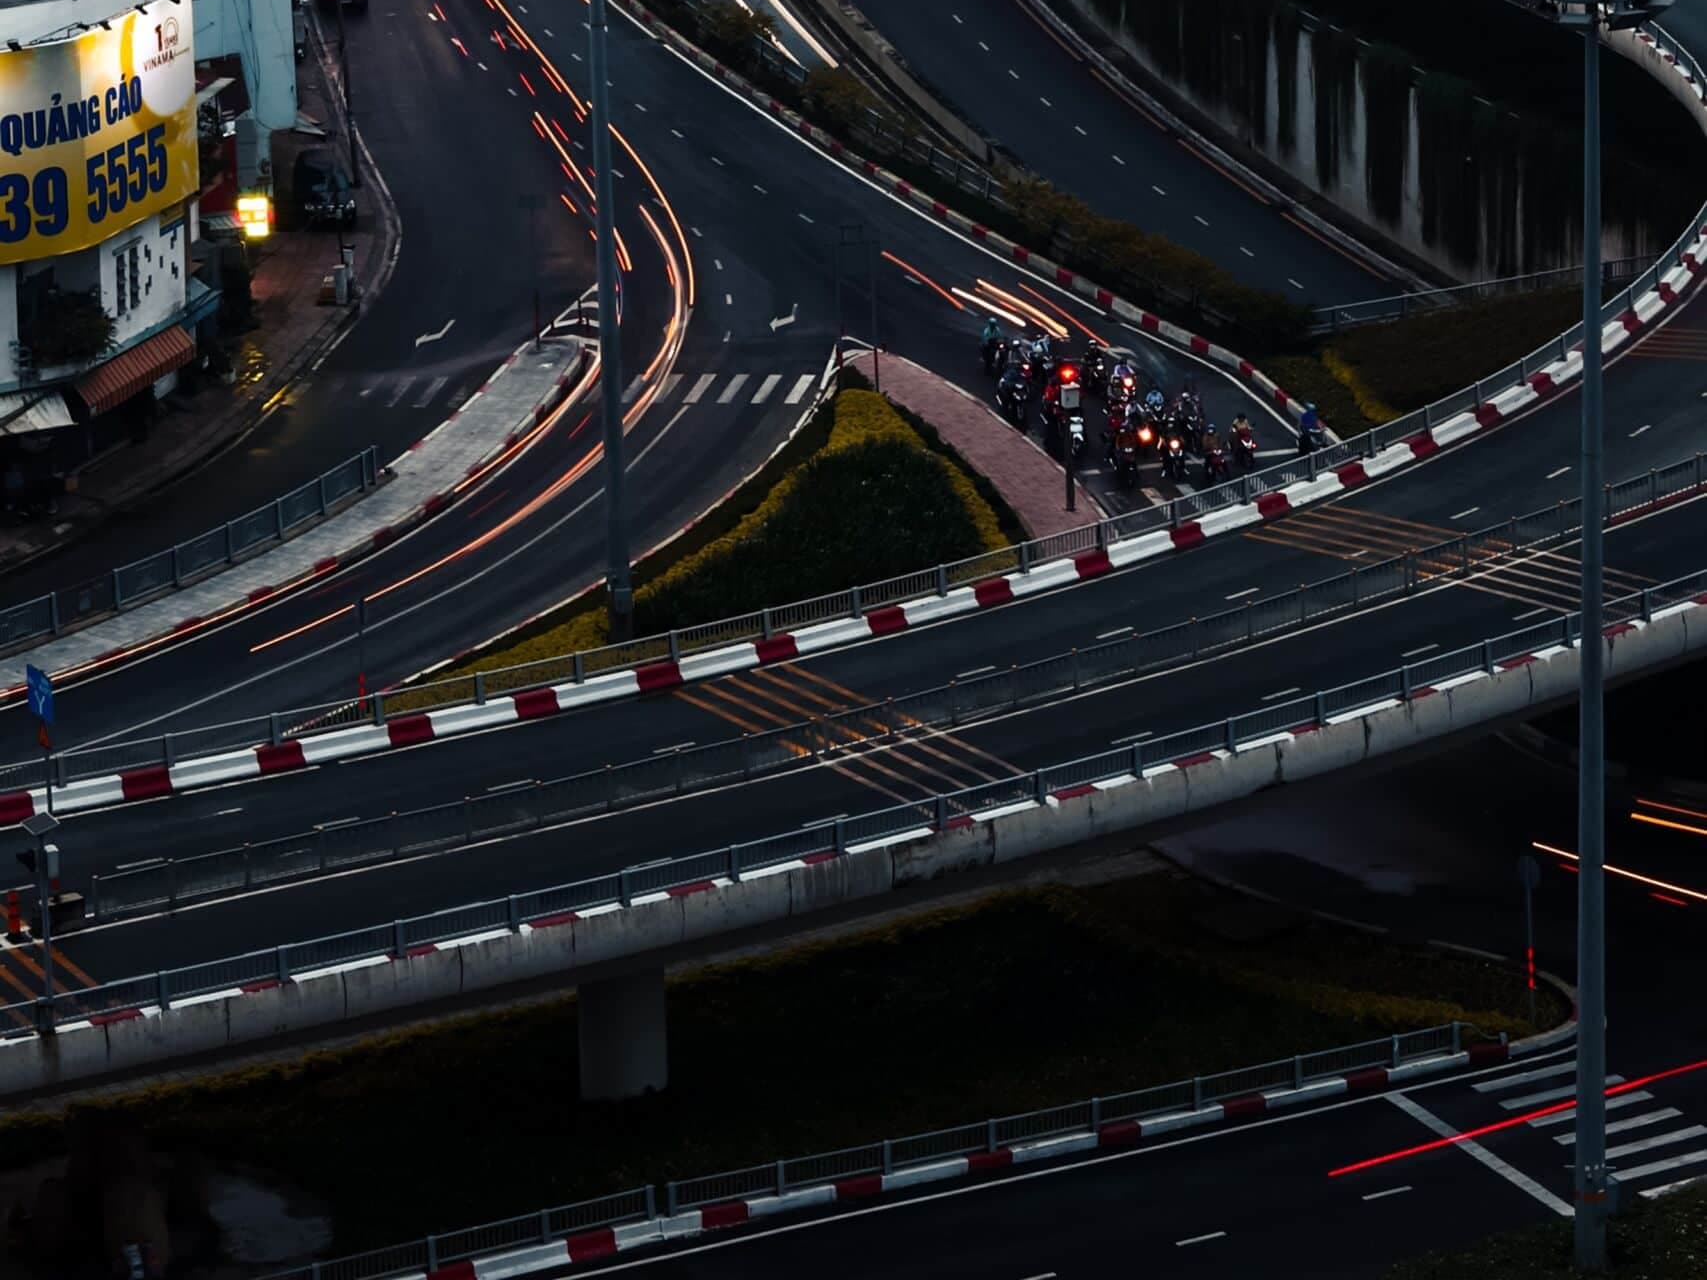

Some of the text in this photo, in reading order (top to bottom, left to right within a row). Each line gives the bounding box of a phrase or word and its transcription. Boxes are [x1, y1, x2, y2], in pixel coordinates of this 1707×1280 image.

[1, 74, 143, 156] QUẢNG CÁO
[86, 123, 169, 224] 5555
